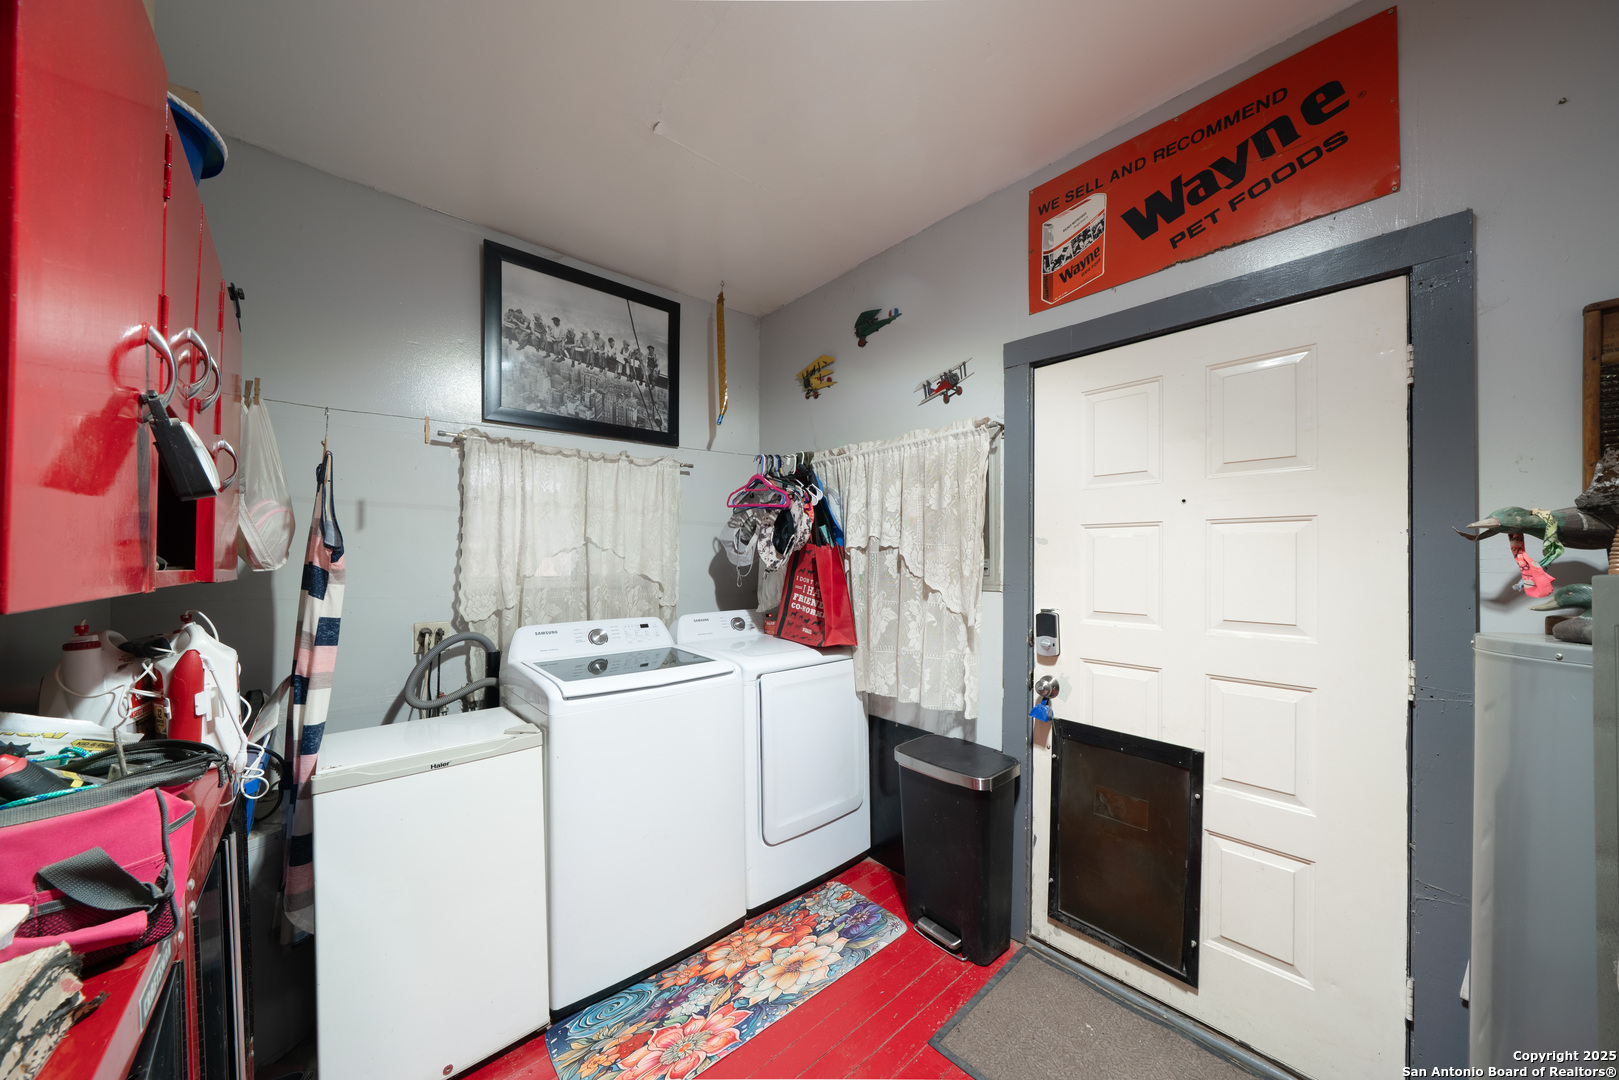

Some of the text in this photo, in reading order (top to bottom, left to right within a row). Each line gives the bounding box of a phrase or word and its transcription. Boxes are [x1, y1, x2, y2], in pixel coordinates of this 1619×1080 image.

[1038, 87, 1289, 215] WE SELL AND RECOMMEND
[1120, 80, 1350, 240] Wayne
[1169, 130, 1349, 249] PET FOODS
[1059, 246, 1101, 284] Wayne
[792, 592, 824, 609] FRIEND
[802, 584, 806, 593] I
[807, 585, 820, 598] HA
[430, 761, 451, 770] Haier
